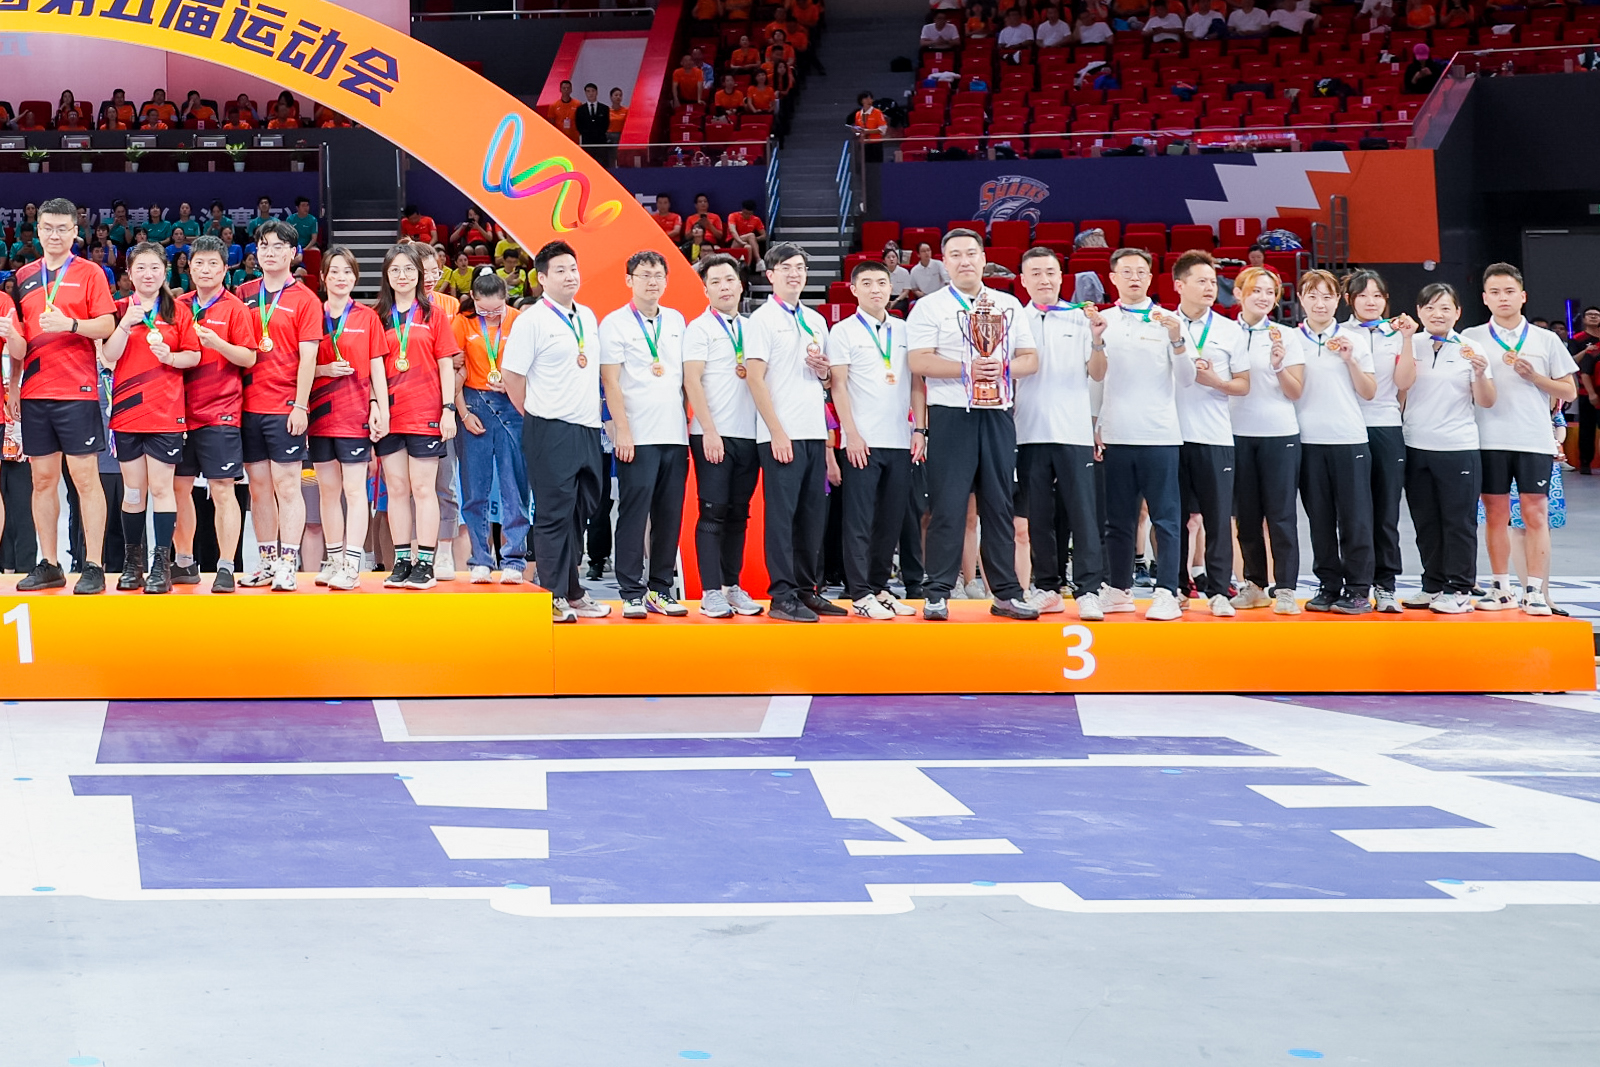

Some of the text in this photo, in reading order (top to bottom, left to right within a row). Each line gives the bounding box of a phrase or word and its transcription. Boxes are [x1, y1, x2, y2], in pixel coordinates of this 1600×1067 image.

[981, 181, 1046, 210] SHARKS
[2, 603, 33, 664] 1
[1062, 624, 1096, 680] 3
